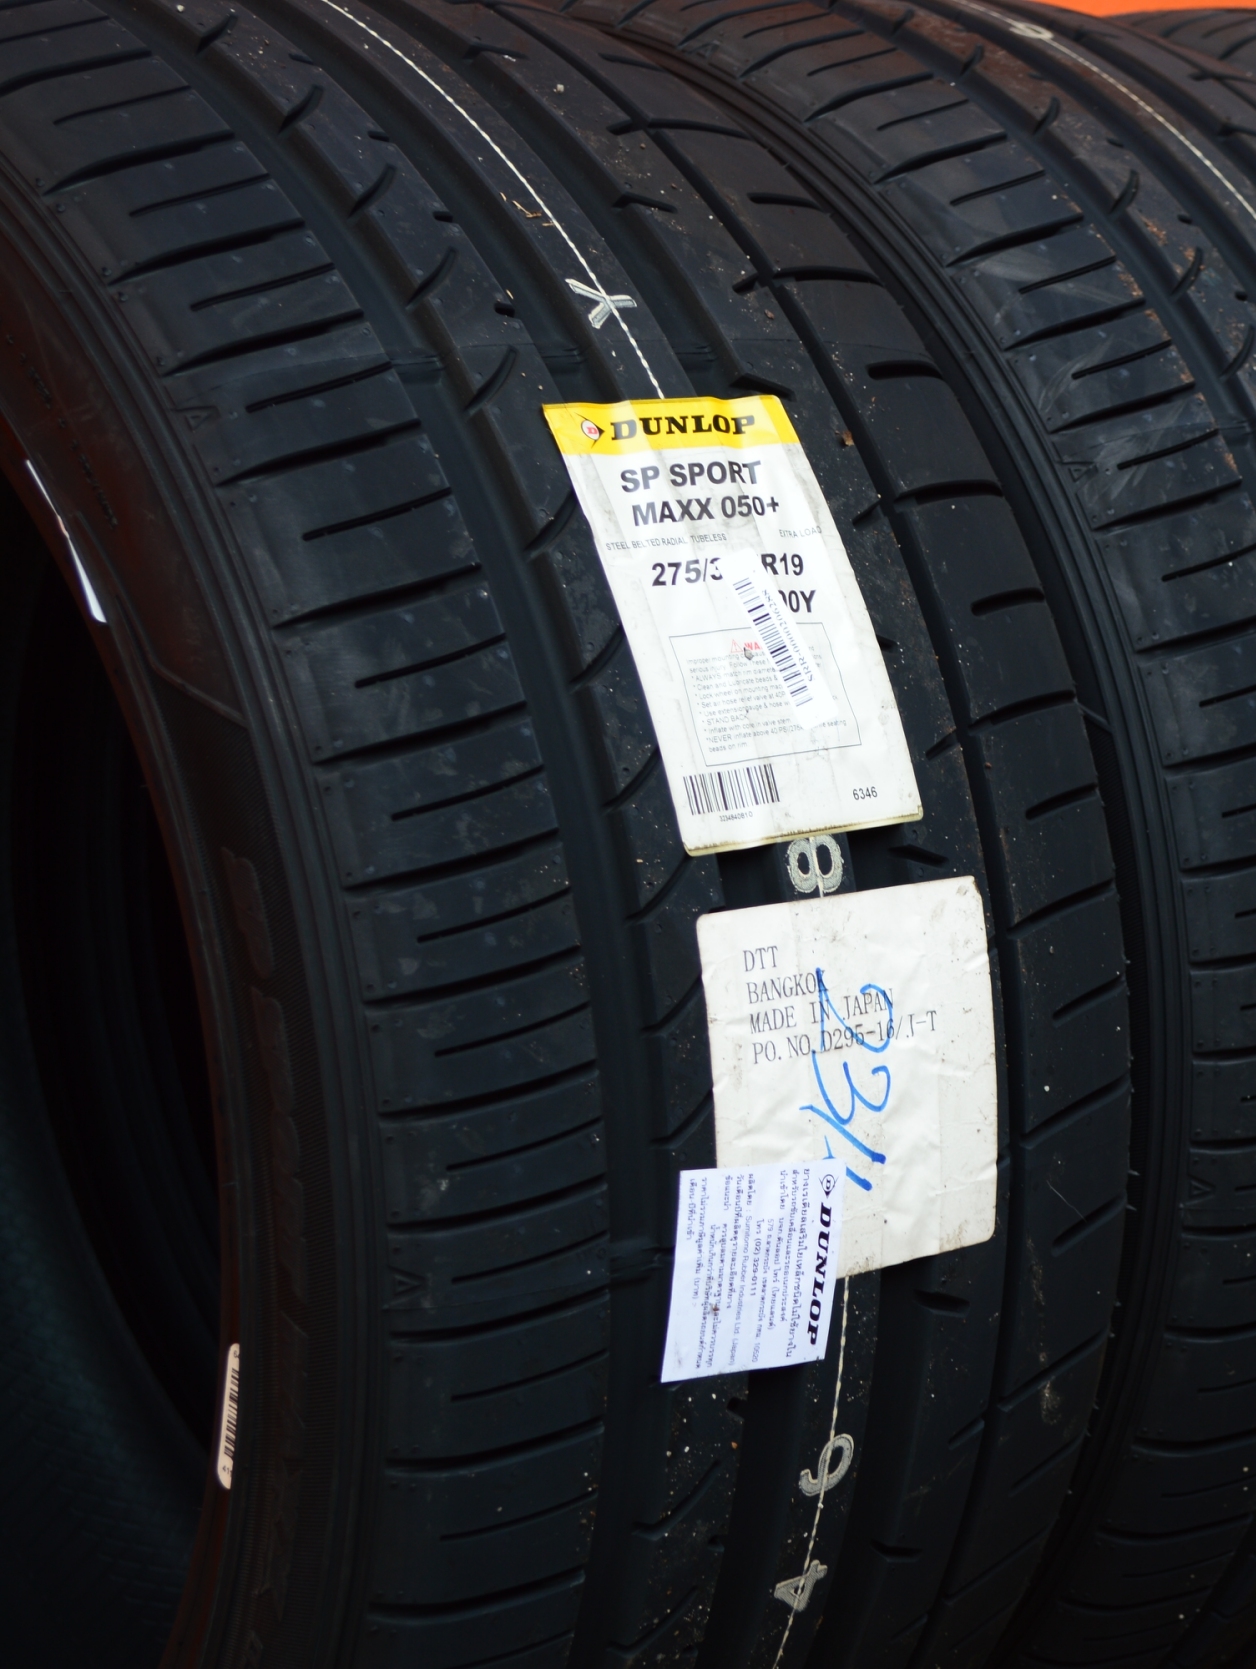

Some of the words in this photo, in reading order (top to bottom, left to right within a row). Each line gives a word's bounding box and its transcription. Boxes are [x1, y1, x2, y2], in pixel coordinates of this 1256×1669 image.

[610, 415, 755, 441] DUNLOP
[620, 466, 660, 492] SP
[670, 461, 761, 487] SPORT
[632, 498, 714, 526] MAXX
[721, 495, 779, 519] 050+
[606, 542, 630, 550] STEEL
[633, 538, 660, 548] BELTED
[662, 537, 688, 546] RADIAL
[690, 533, 727, 543] TUBELESS
[779, 528, 799, 538] EXTRA
[799, 525, 822, 538] LOAD
[652, 554, 803, 586] 275/3R19
[852, 786, 878, 801] 6346
[743, 945, 778, 972] DTT
[745, 970, 828, 1005] BANGKOK
[749, 1006, 797, 1034] MADE
[810, 1000, 830, 1024] IN
[842, 988, 894, 1020] JAPAN
[743, 1216, 752, 1253] Sumitomo
[753, 1238, 761, 1255] (02)
[740, 1255, 749, 1282] Rubber
[751, 1258, 759, 1296] 329-0111
[808, 1204, 831, 1344] DUNLOP
[736, 1285, 745, 1320] Industries
[728, 1338, 738, 1366] (Japan)
